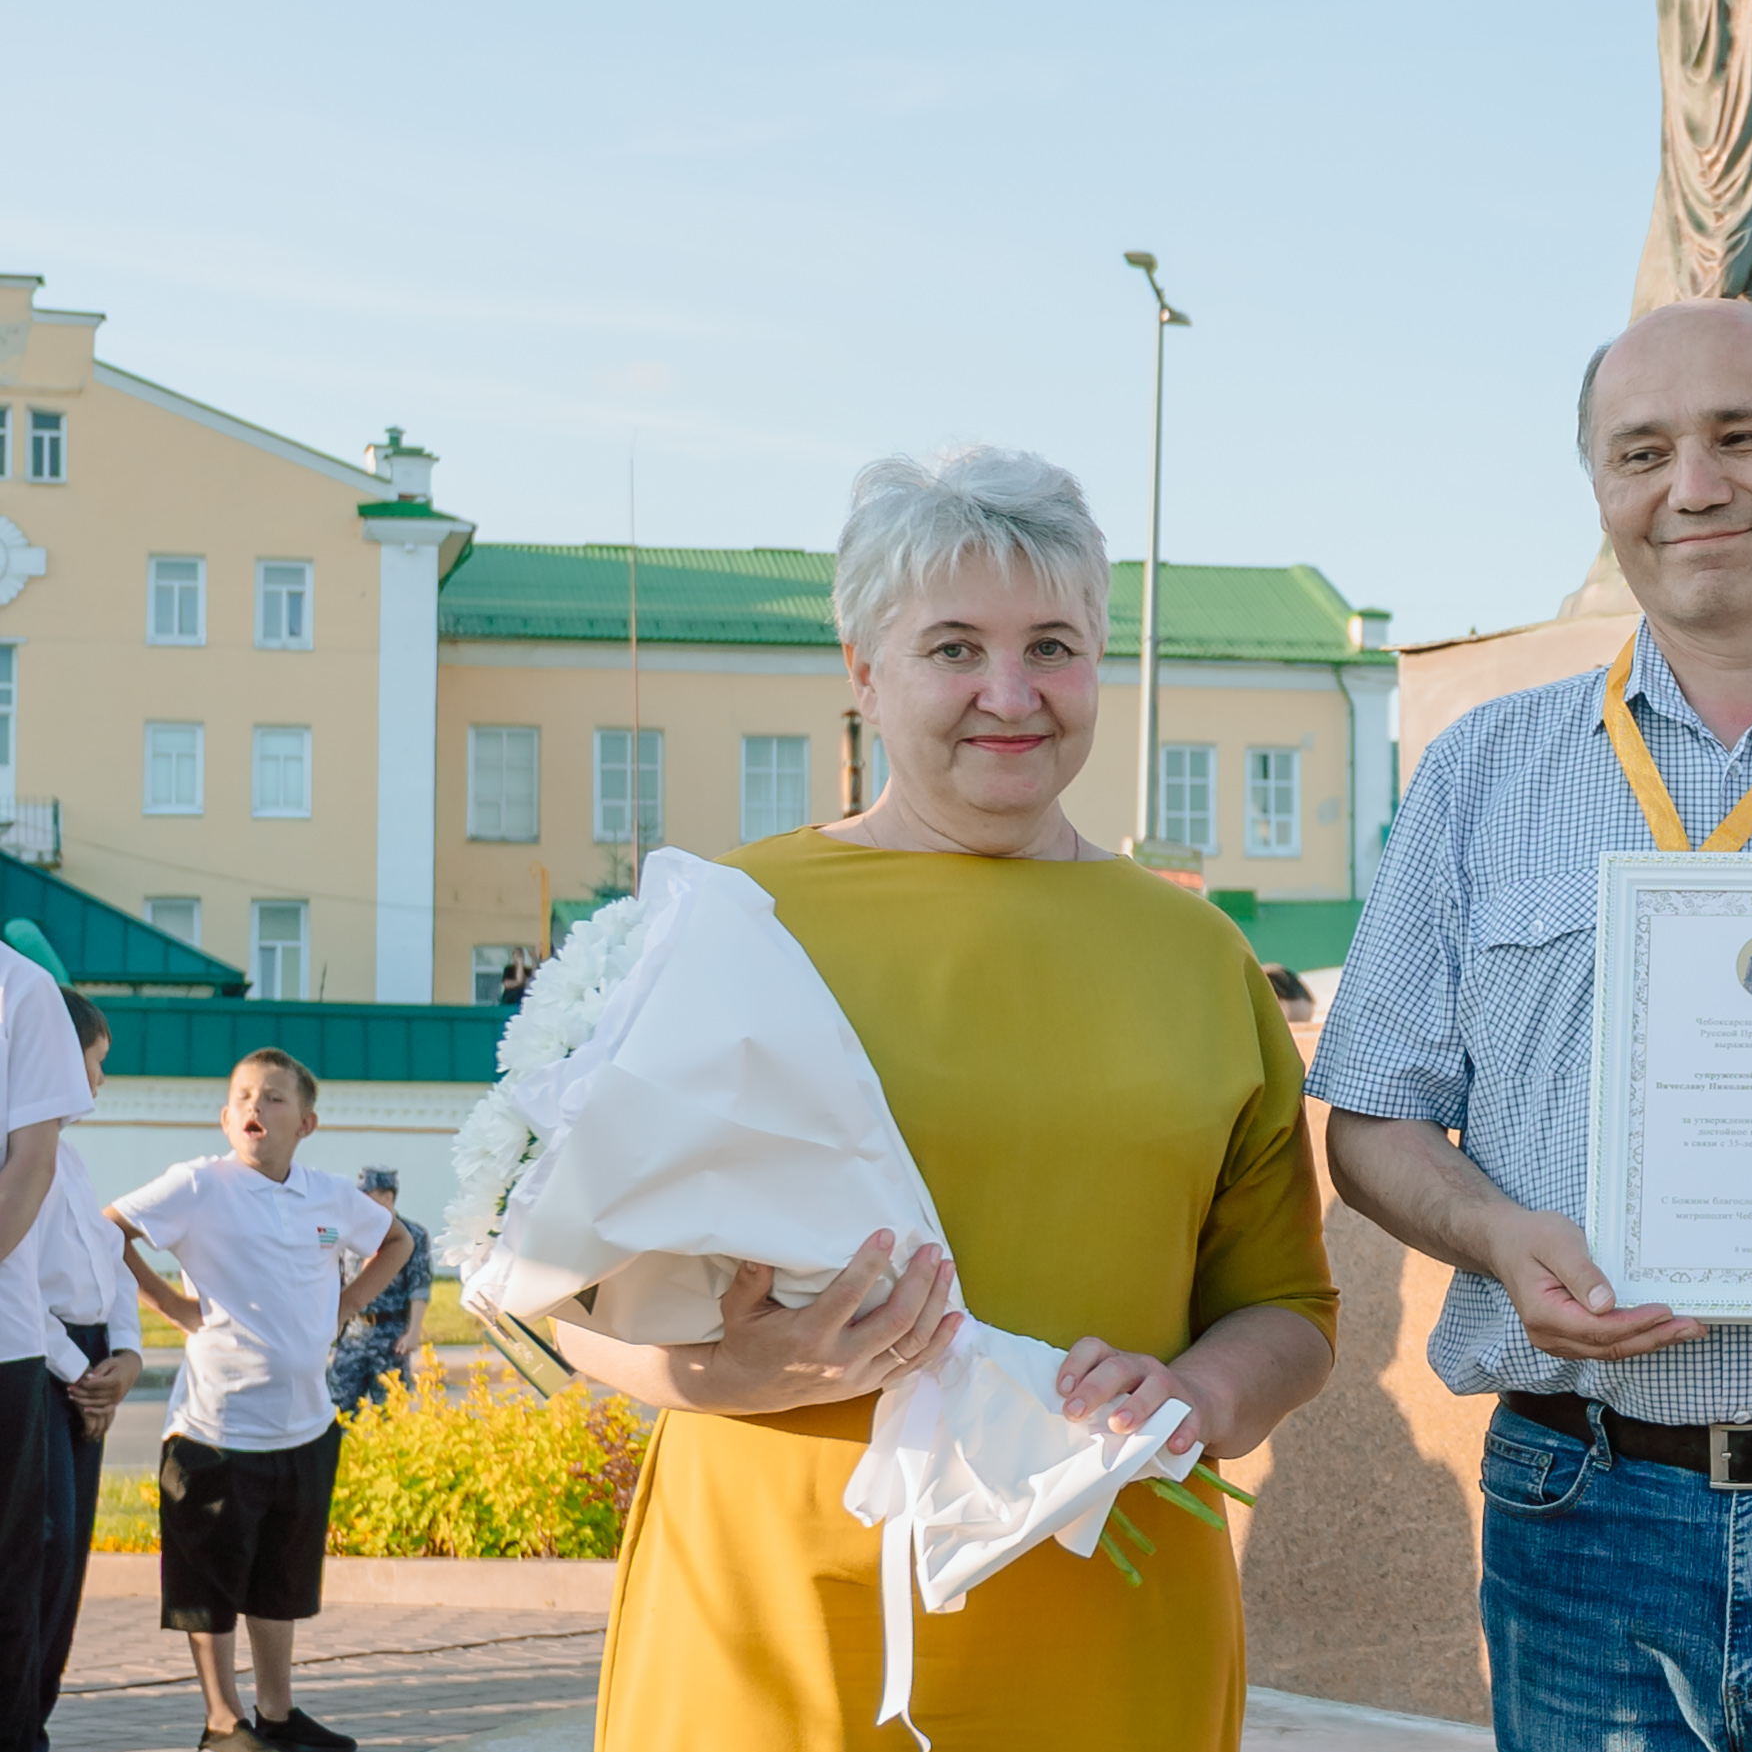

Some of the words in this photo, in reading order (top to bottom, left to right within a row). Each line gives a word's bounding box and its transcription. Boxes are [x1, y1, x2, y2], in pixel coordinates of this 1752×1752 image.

[1700, 1029, 1738, 1039] Русской
[1655, 1082, 1706, 1091] Вячеславу
[1697, 1128, 1748, 1136] достойное
[1661, 1196, 1669, 1204] С
[1676, 1213, 1733, 1221] митрополит
